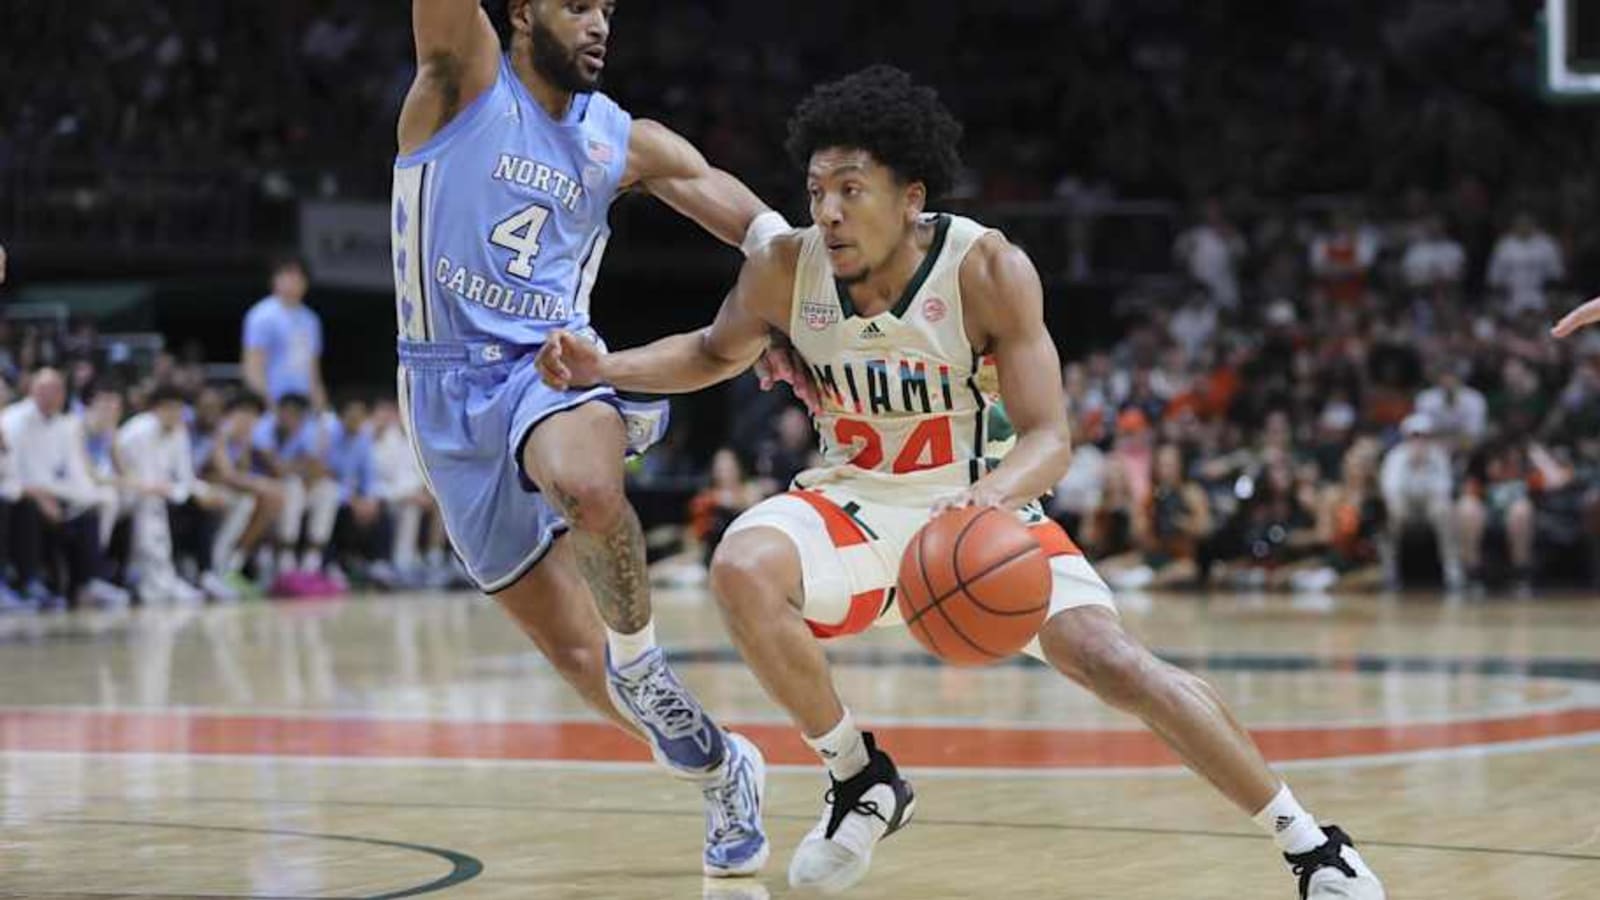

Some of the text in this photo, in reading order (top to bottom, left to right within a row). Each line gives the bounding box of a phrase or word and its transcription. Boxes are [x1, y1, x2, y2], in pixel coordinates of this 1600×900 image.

[492, 153, 583, 213] NORTH
[488, 202, 551, 281] 4
[435, 256, 577, 323] CAROLINA
[813, 359, 954, 415] MIAMI
[834, 415, 955, 475] 24
